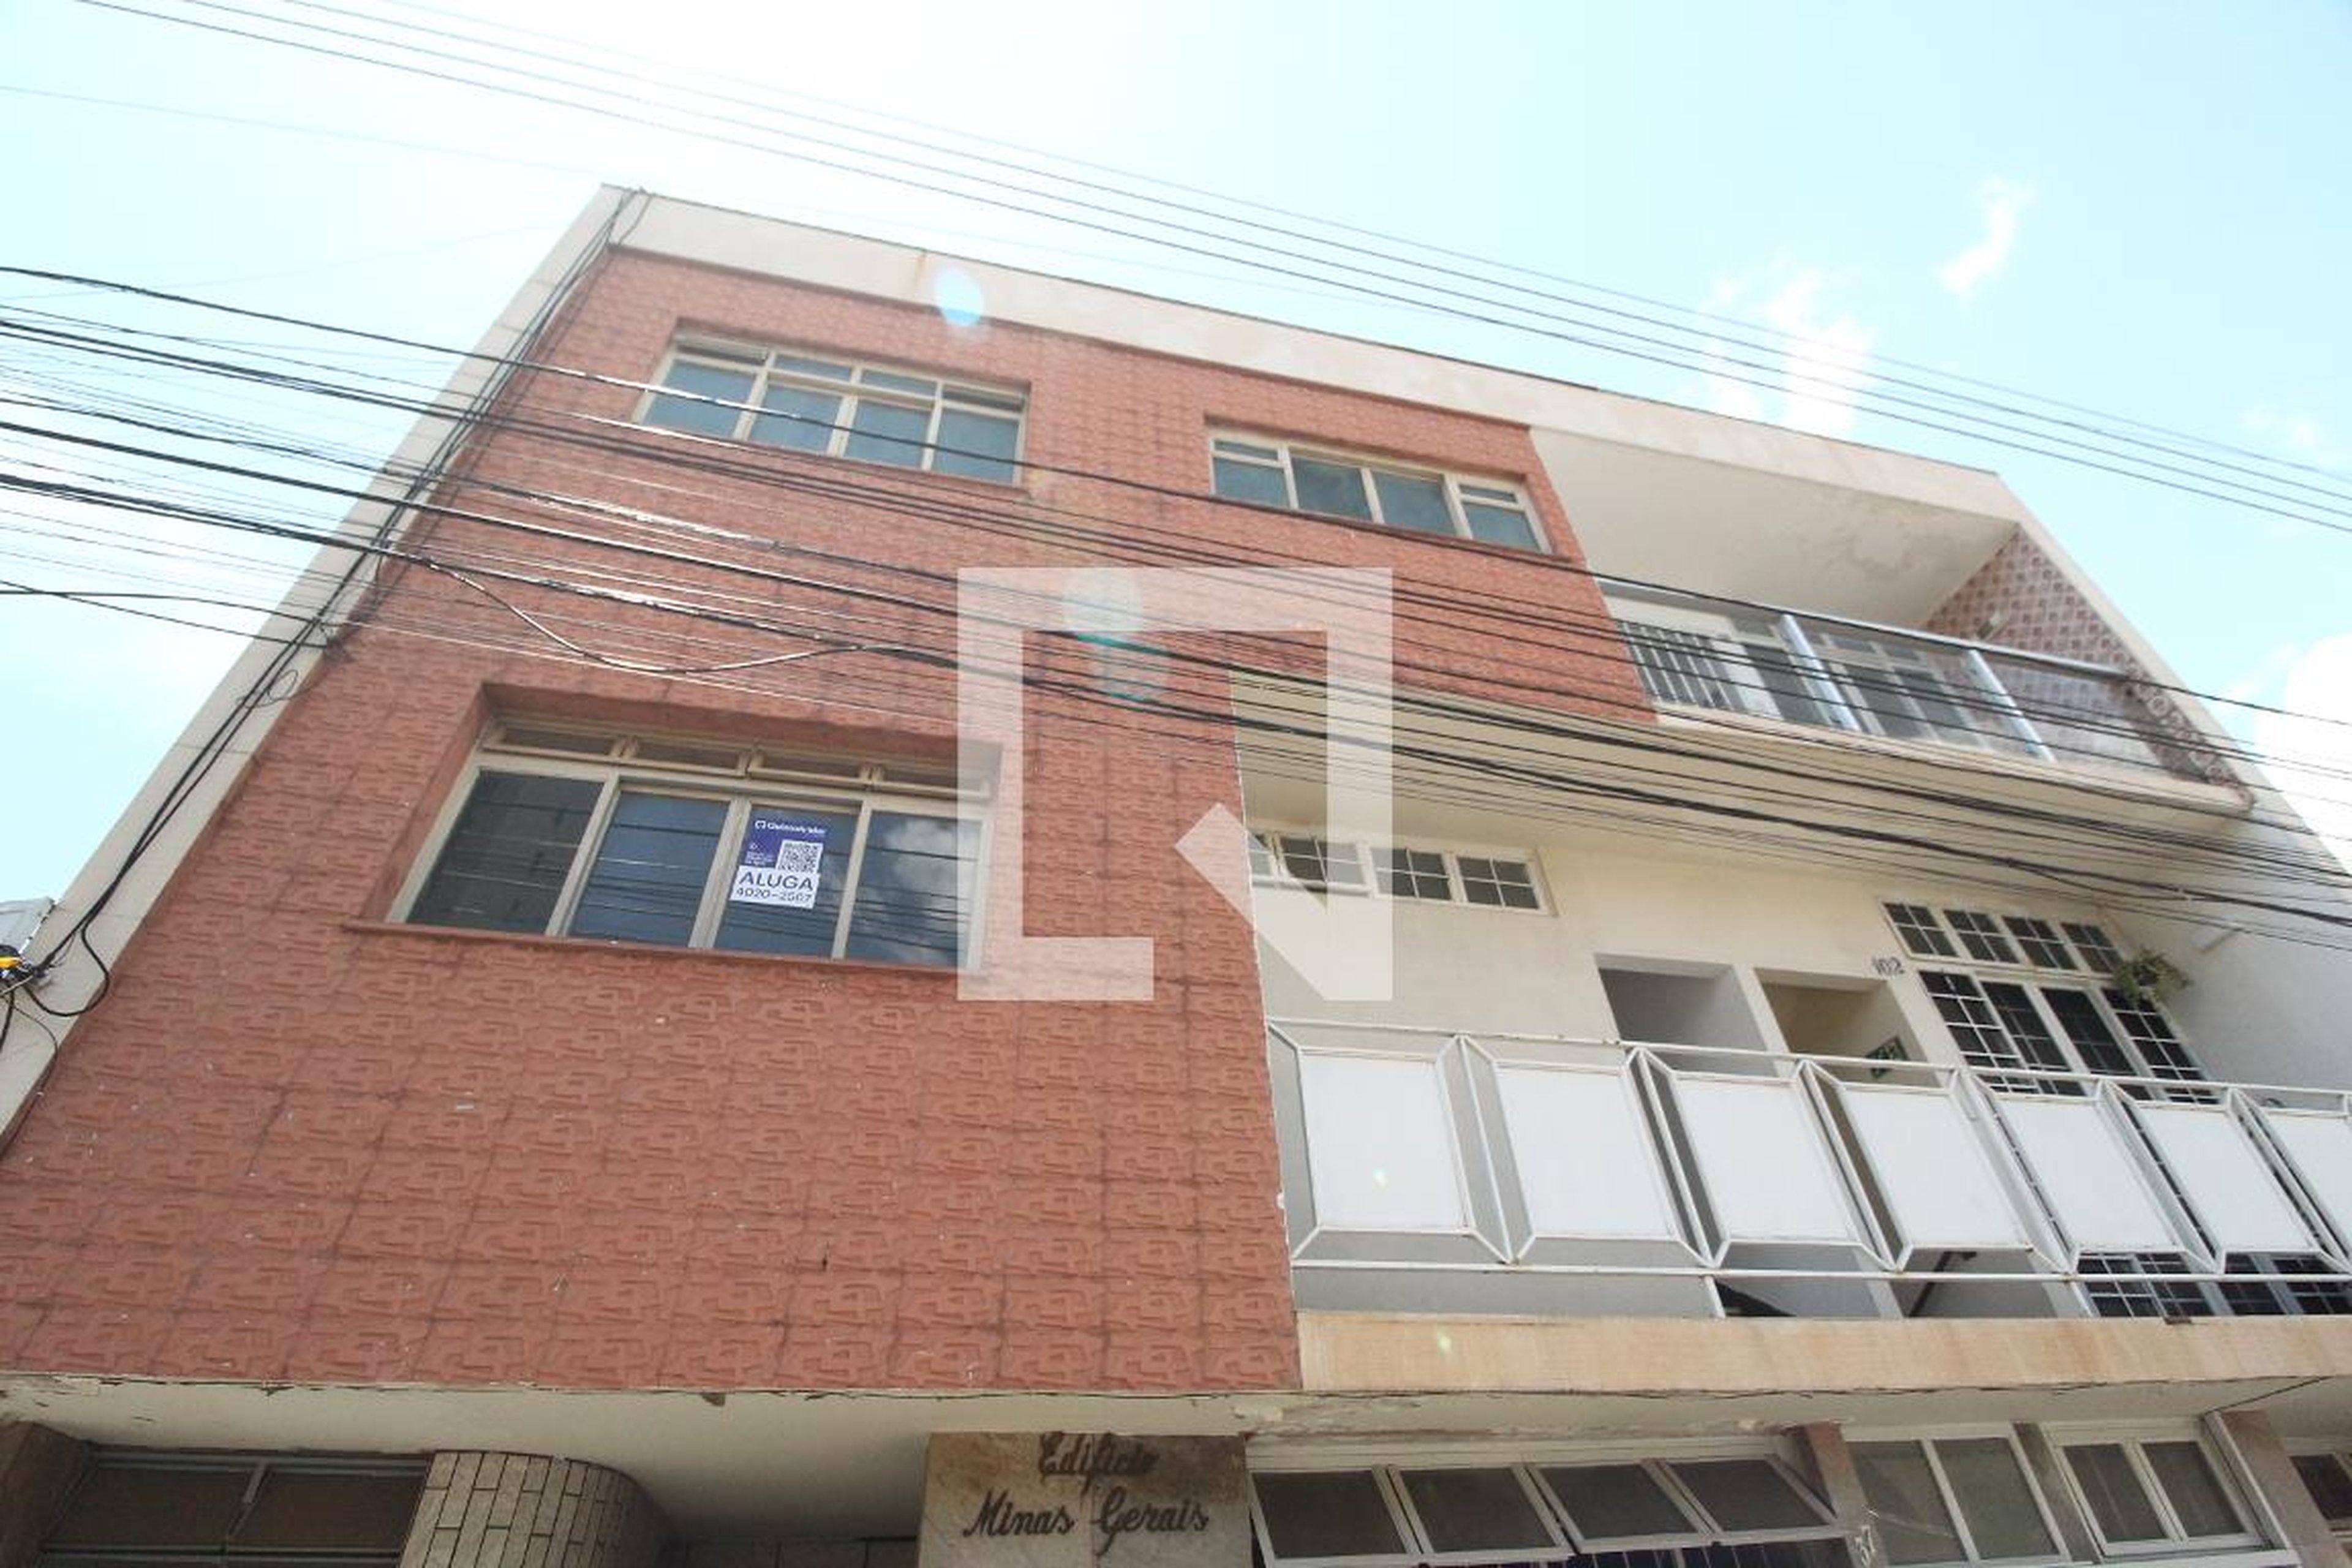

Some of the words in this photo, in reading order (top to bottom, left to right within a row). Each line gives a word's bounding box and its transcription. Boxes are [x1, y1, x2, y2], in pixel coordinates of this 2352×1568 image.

[739, 872, 813, 891] ALUGA
[1871, 956, 1904, 975] 102
[963, 1488, 1076, 1537] Minas
[1090, 1487, 1209, 1557] Gerais
